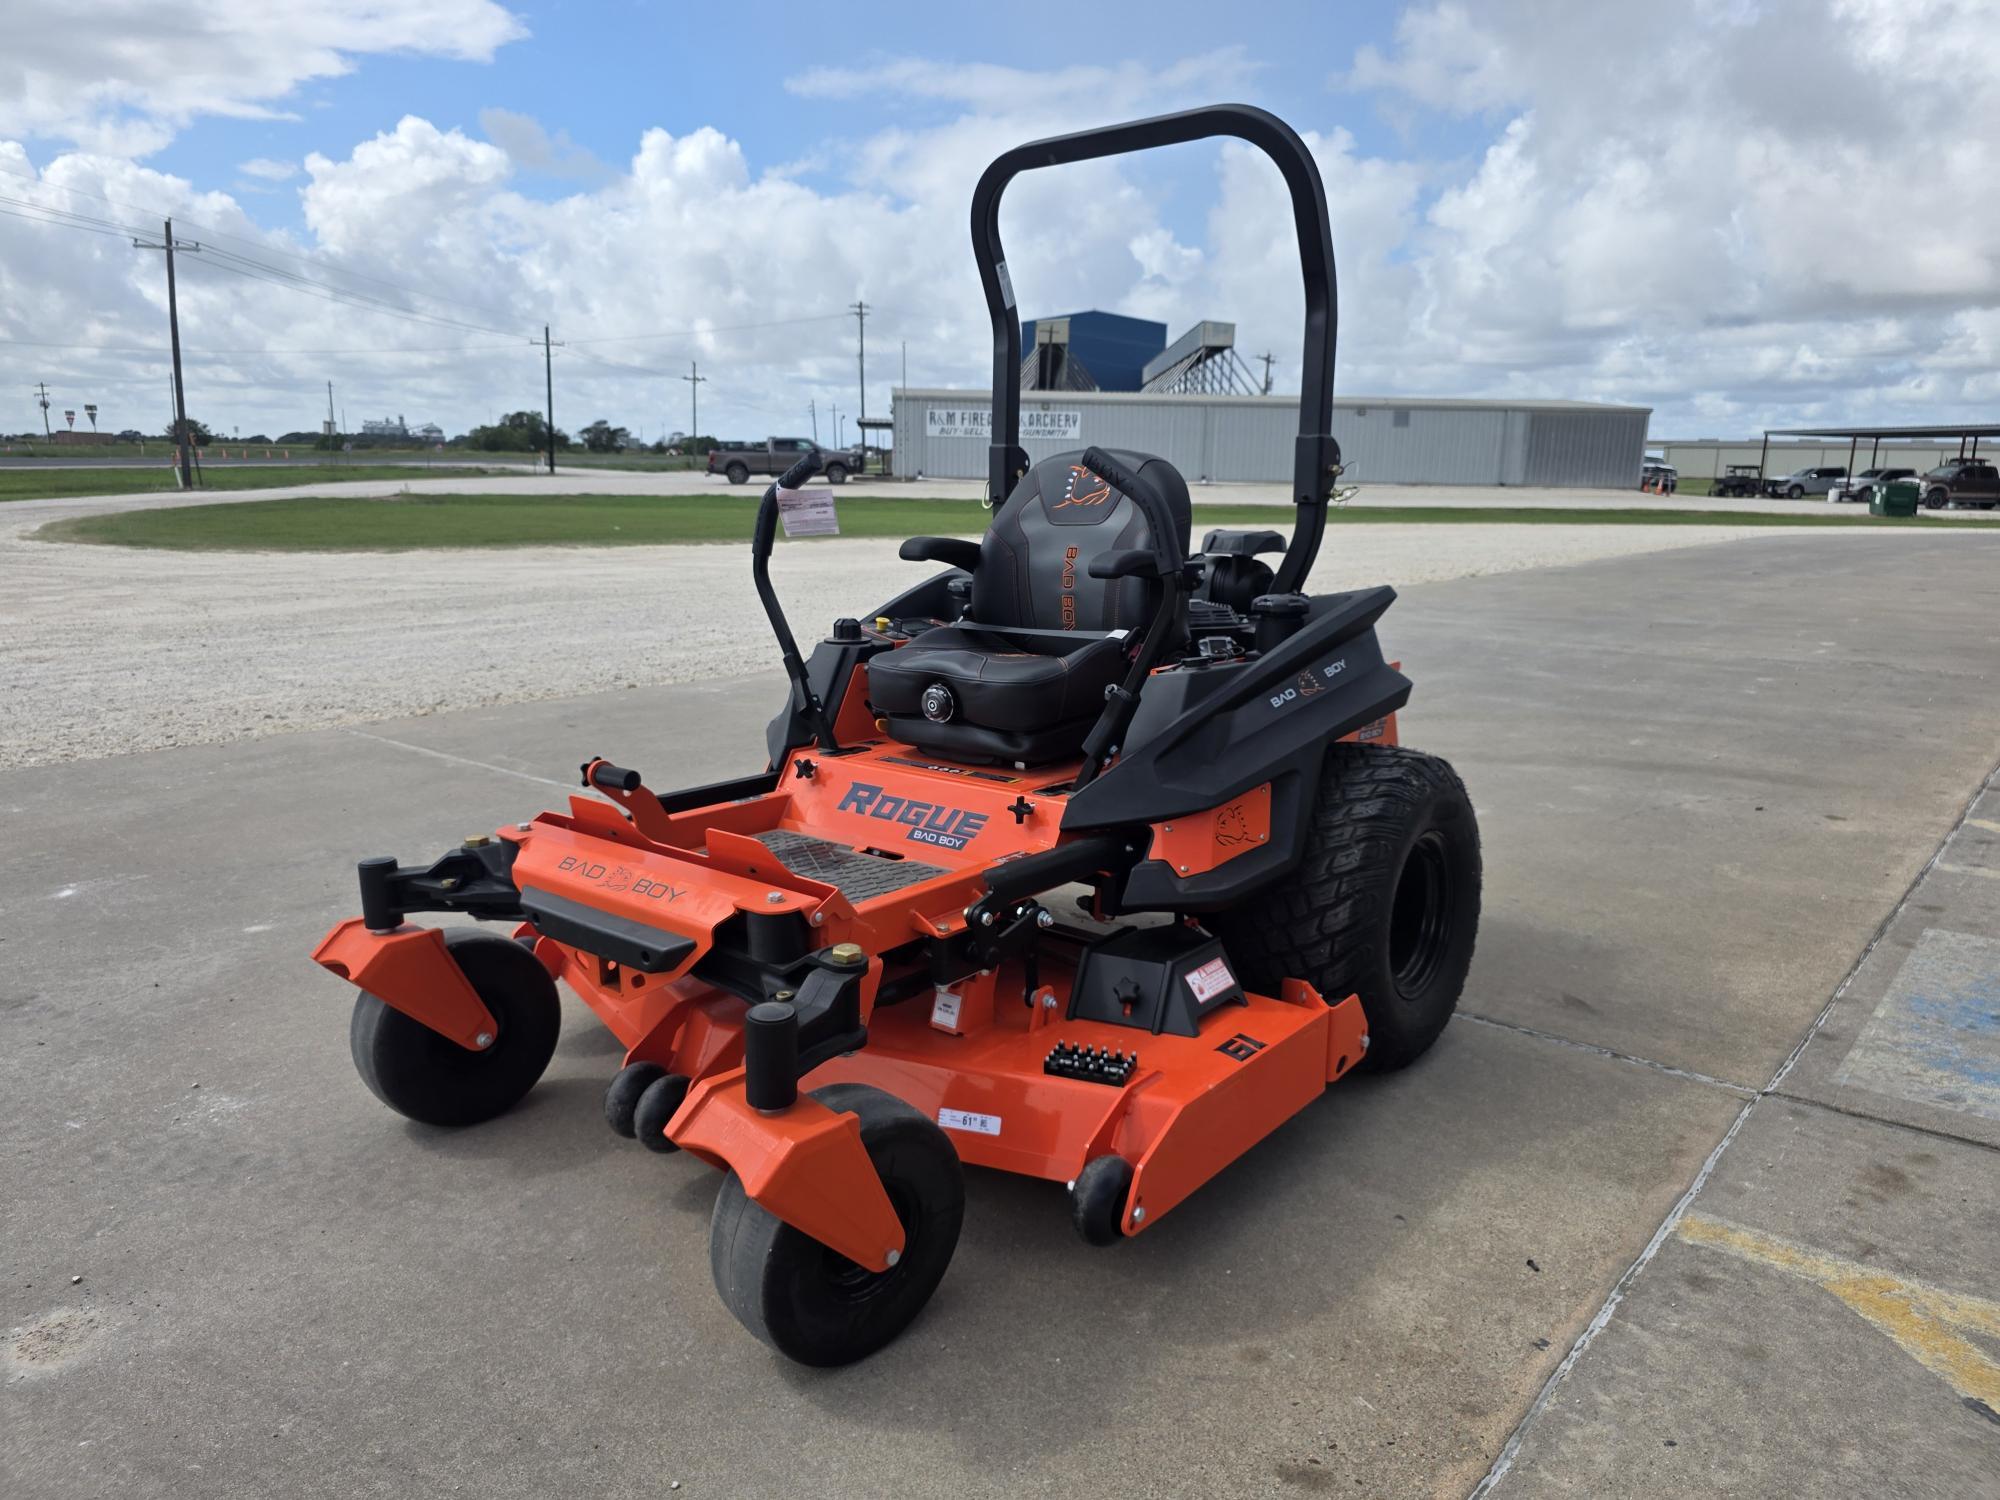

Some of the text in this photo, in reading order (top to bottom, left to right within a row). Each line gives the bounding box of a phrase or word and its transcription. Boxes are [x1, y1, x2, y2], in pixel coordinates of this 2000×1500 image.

[929, 411, 956, 426] R&M
[1028, 413, 1078, 429] ARCHERY
[1063, 545, 1078, 589] BAD
[1270, 659, 1347, 708] BAD BOY
[837, 782, 990, 839] ROGUE
[913, 830, 963, 848] BAD BOY
[558, 856, 687, 903] BAD BOY
